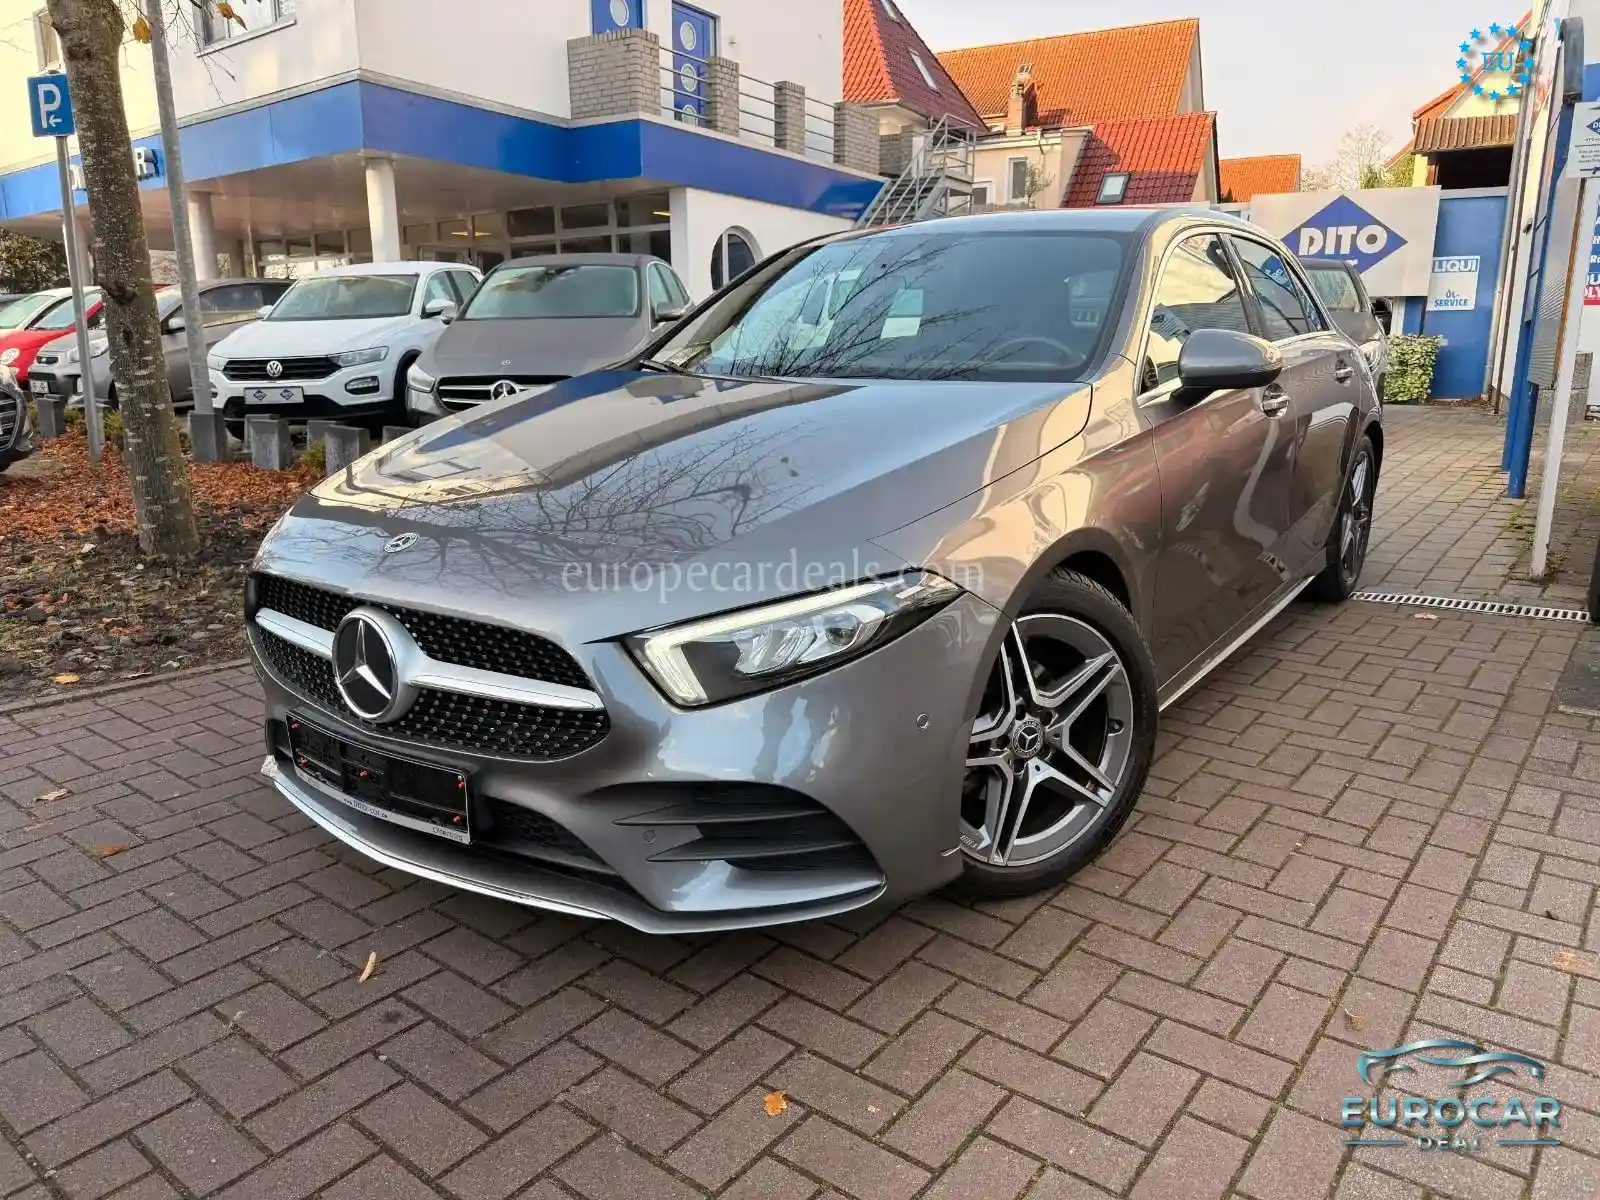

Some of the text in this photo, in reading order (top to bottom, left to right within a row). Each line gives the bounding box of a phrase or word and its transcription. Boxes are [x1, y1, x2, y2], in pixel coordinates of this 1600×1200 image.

[38, 83, 61, 128] P
[1298, 224, 1388, 256] DITO
[1433, 259, 1477, 273] LIQUI
[1434, 298, 1470, 307] SERVICE
